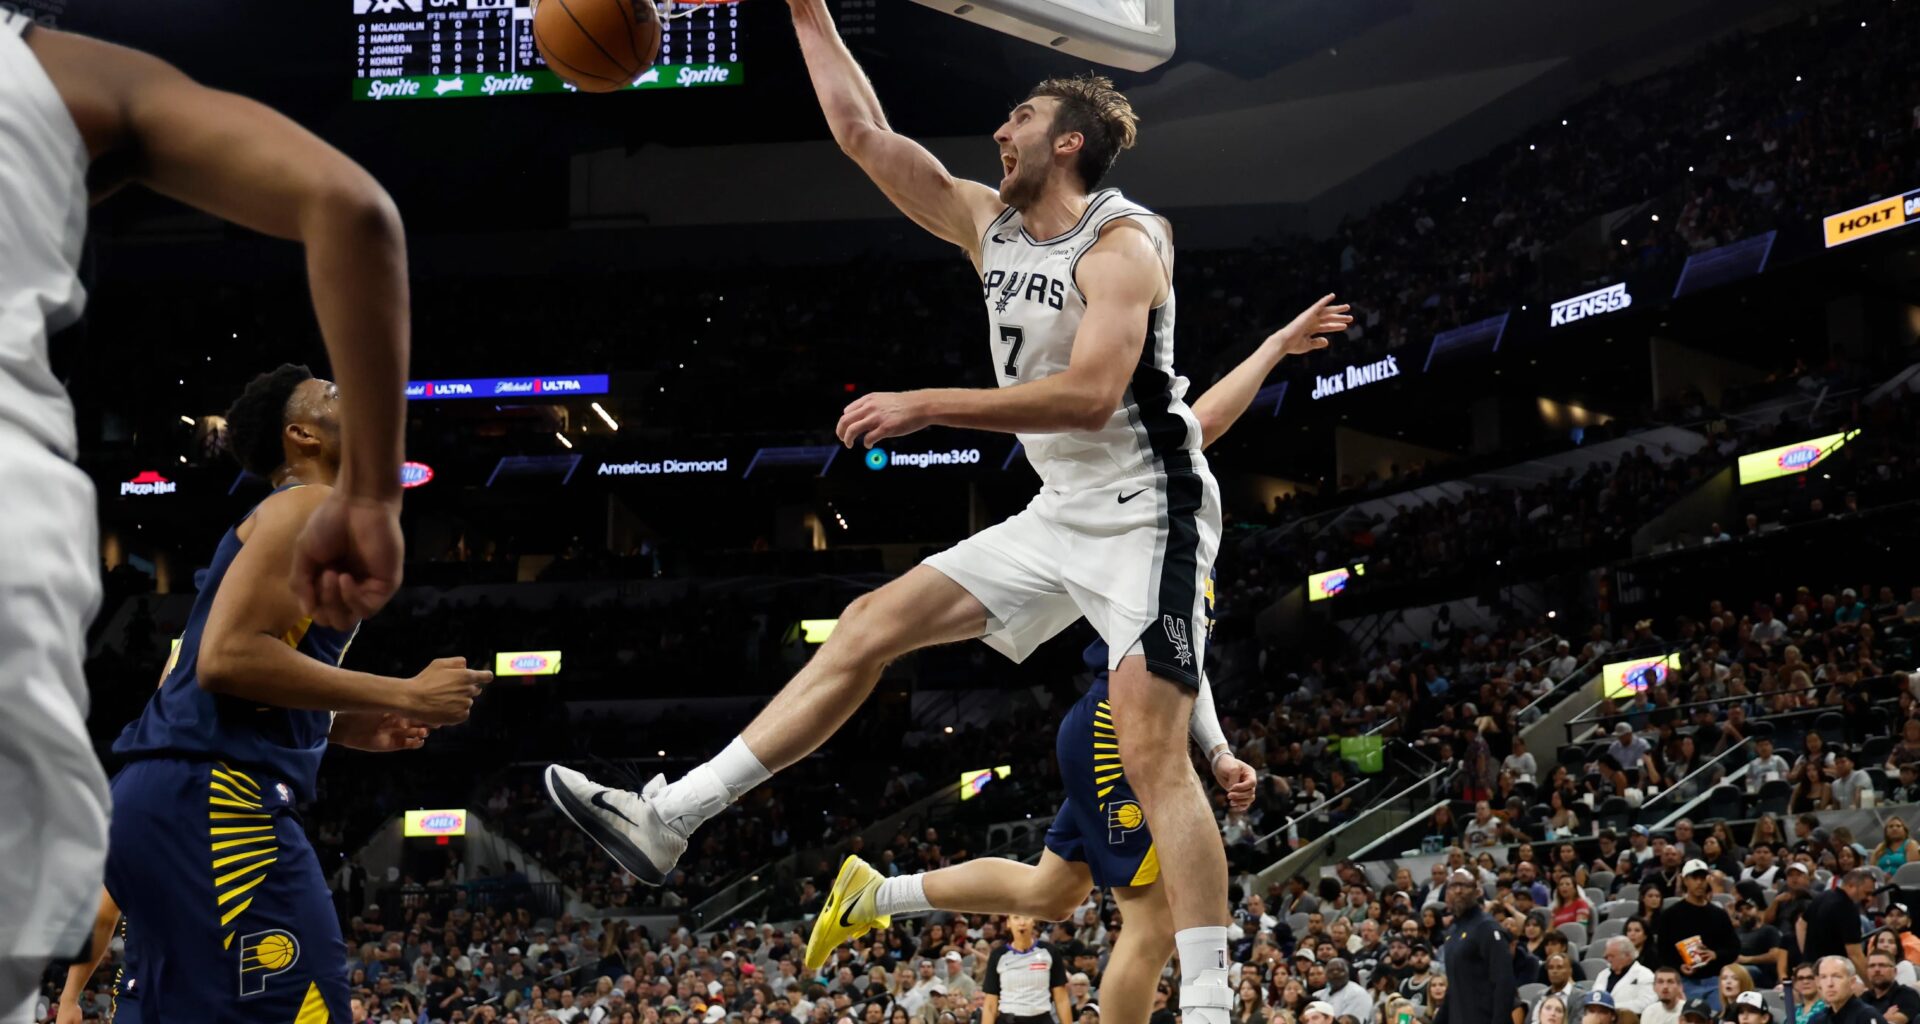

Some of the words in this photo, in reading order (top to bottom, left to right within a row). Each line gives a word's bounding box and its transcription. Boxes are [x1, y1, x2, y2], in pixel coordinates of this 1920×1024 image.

[471, 10, 491, 18] AST
[707, 9, 715, 18] 4
[370, 21, 425, 32] MCLAUGHLIN
[454, 20, 462, 29] 0
[479, 19, 484, 29] 1
[498, 18, 506, 28] 0
[662, 22, 671, 32] 0
[687, 21, 692, 31] 1
[709, 20, 714, 30] 1
[729, 18, 738, 29] 0
[370, 33, 405, 44] HARPER
[500, 29, 505, 39] 1
[662, 33, 671, 43] 0
[687, 32, 692, 42] 1
[707, 31, 716, 41] 0
[731, 30, 736, 40] 1
[370, 44, 413, 55] JOHNSON
[454, 42, 462, 52] 0
[479, 41, 484, 51] 1
[500, 40, 505, 50] 1
[662, 44, 671, 54] 0
[687, 43, 692, 53] 1
[707, 42, 716, 52] 0
[731, 41, 736, 51] 1
[369, 56, 404, 67] KORNET
[476, 52, 485, 62] 0
[729, 52, 738, 63] 0
[369, 67, 403, 78] BRYANT
[432, 65, 440, 76] 0
[499, 62, 505, 72] 1
[367, 78, 420, 100] Sprite
[480, 74, 533, 96] Sprite
[676, 65, 729, 87] Sprite
[1839, 206, 1896, 234] HOLT
[998, 323, 1026, 381] 7
[434, 384, 472, 395] ULTRA
[542, 380, 581, 391] ULTRA
[1312, 375, 1345, 400] JACK
[891, 449, 980, 468] imagine360
[597, 460, 661, 475] Americus
[663, 458, 727, 473] Diamond
[121, 481, 154, 495] Pizza
[154, 480, 176, 494] Hut
